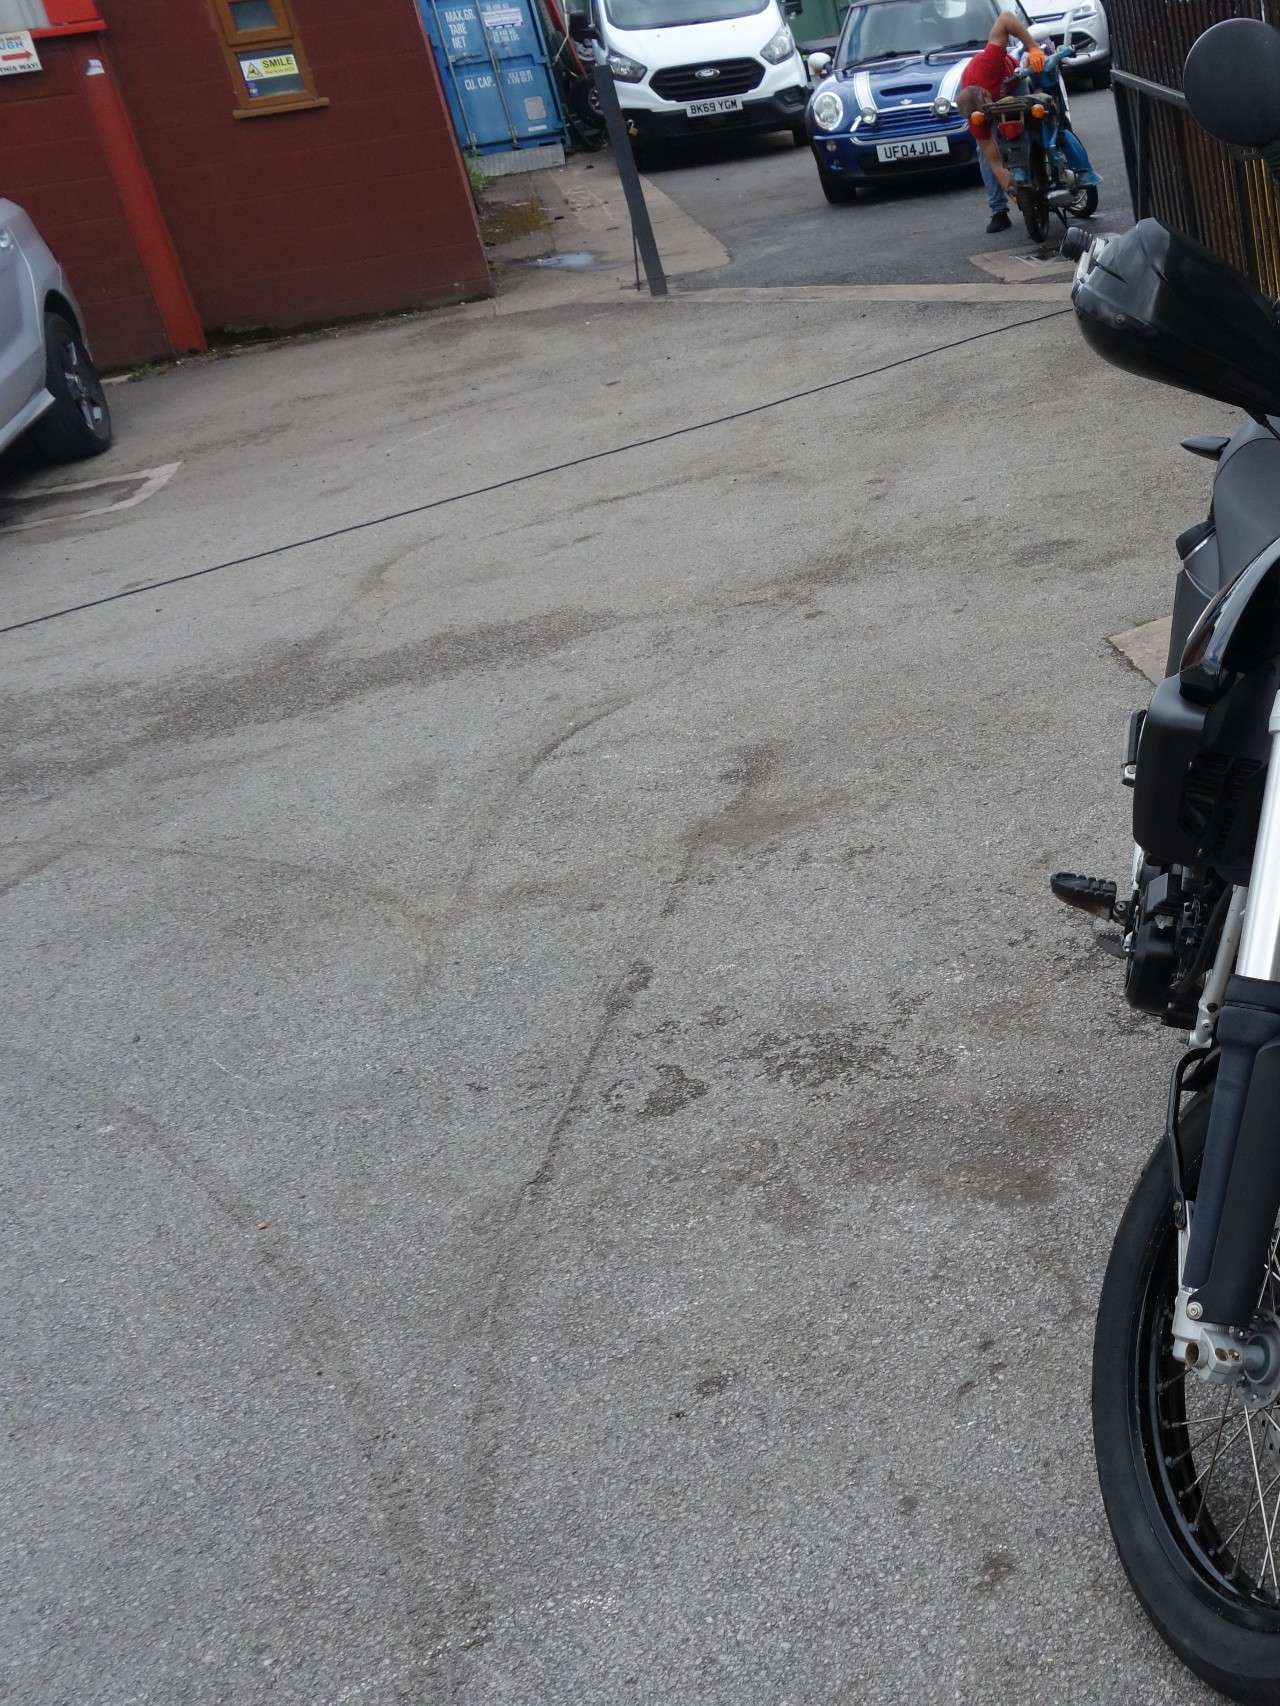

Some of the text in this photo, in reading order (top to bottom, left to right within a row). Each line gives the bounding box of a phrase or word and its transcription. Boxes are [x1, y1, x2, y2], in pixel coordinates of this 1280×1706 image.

[449, 22, 467, 35] TARE
[452, 36, 466, 49] NET
[262, 56, 294, 68] SMILE
[690, 100, 738, 114] BK69 YGM
